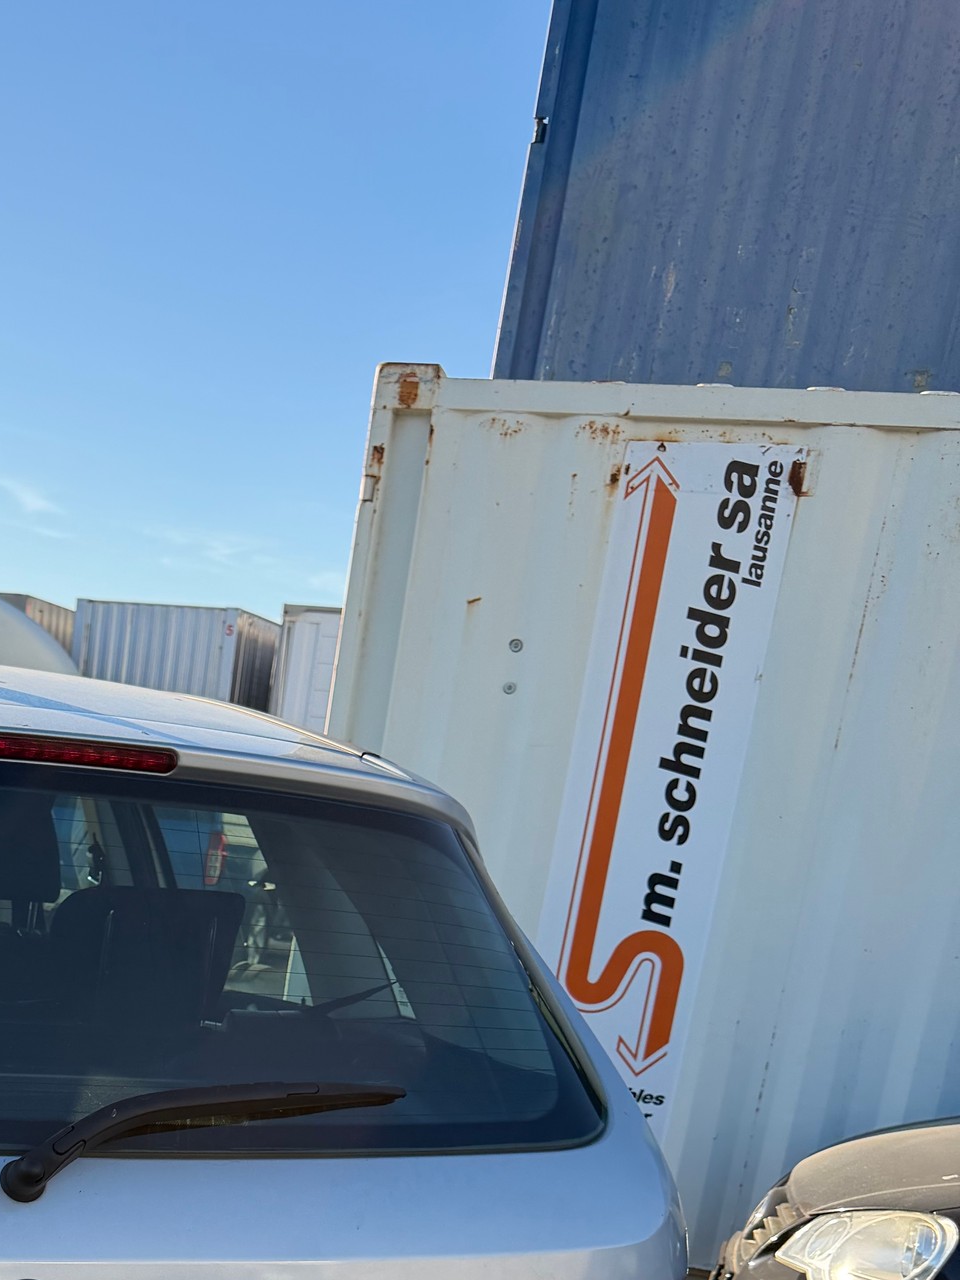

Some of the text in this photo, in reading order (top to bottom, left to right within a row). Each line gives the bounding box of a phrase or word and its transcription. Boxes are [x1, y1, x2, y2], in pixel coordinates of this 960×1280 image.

[741, 460, 784, 588] lausanne
[640, 459, 760, 927] m. schneider sa
[629, 1087, 665, 1106] les
